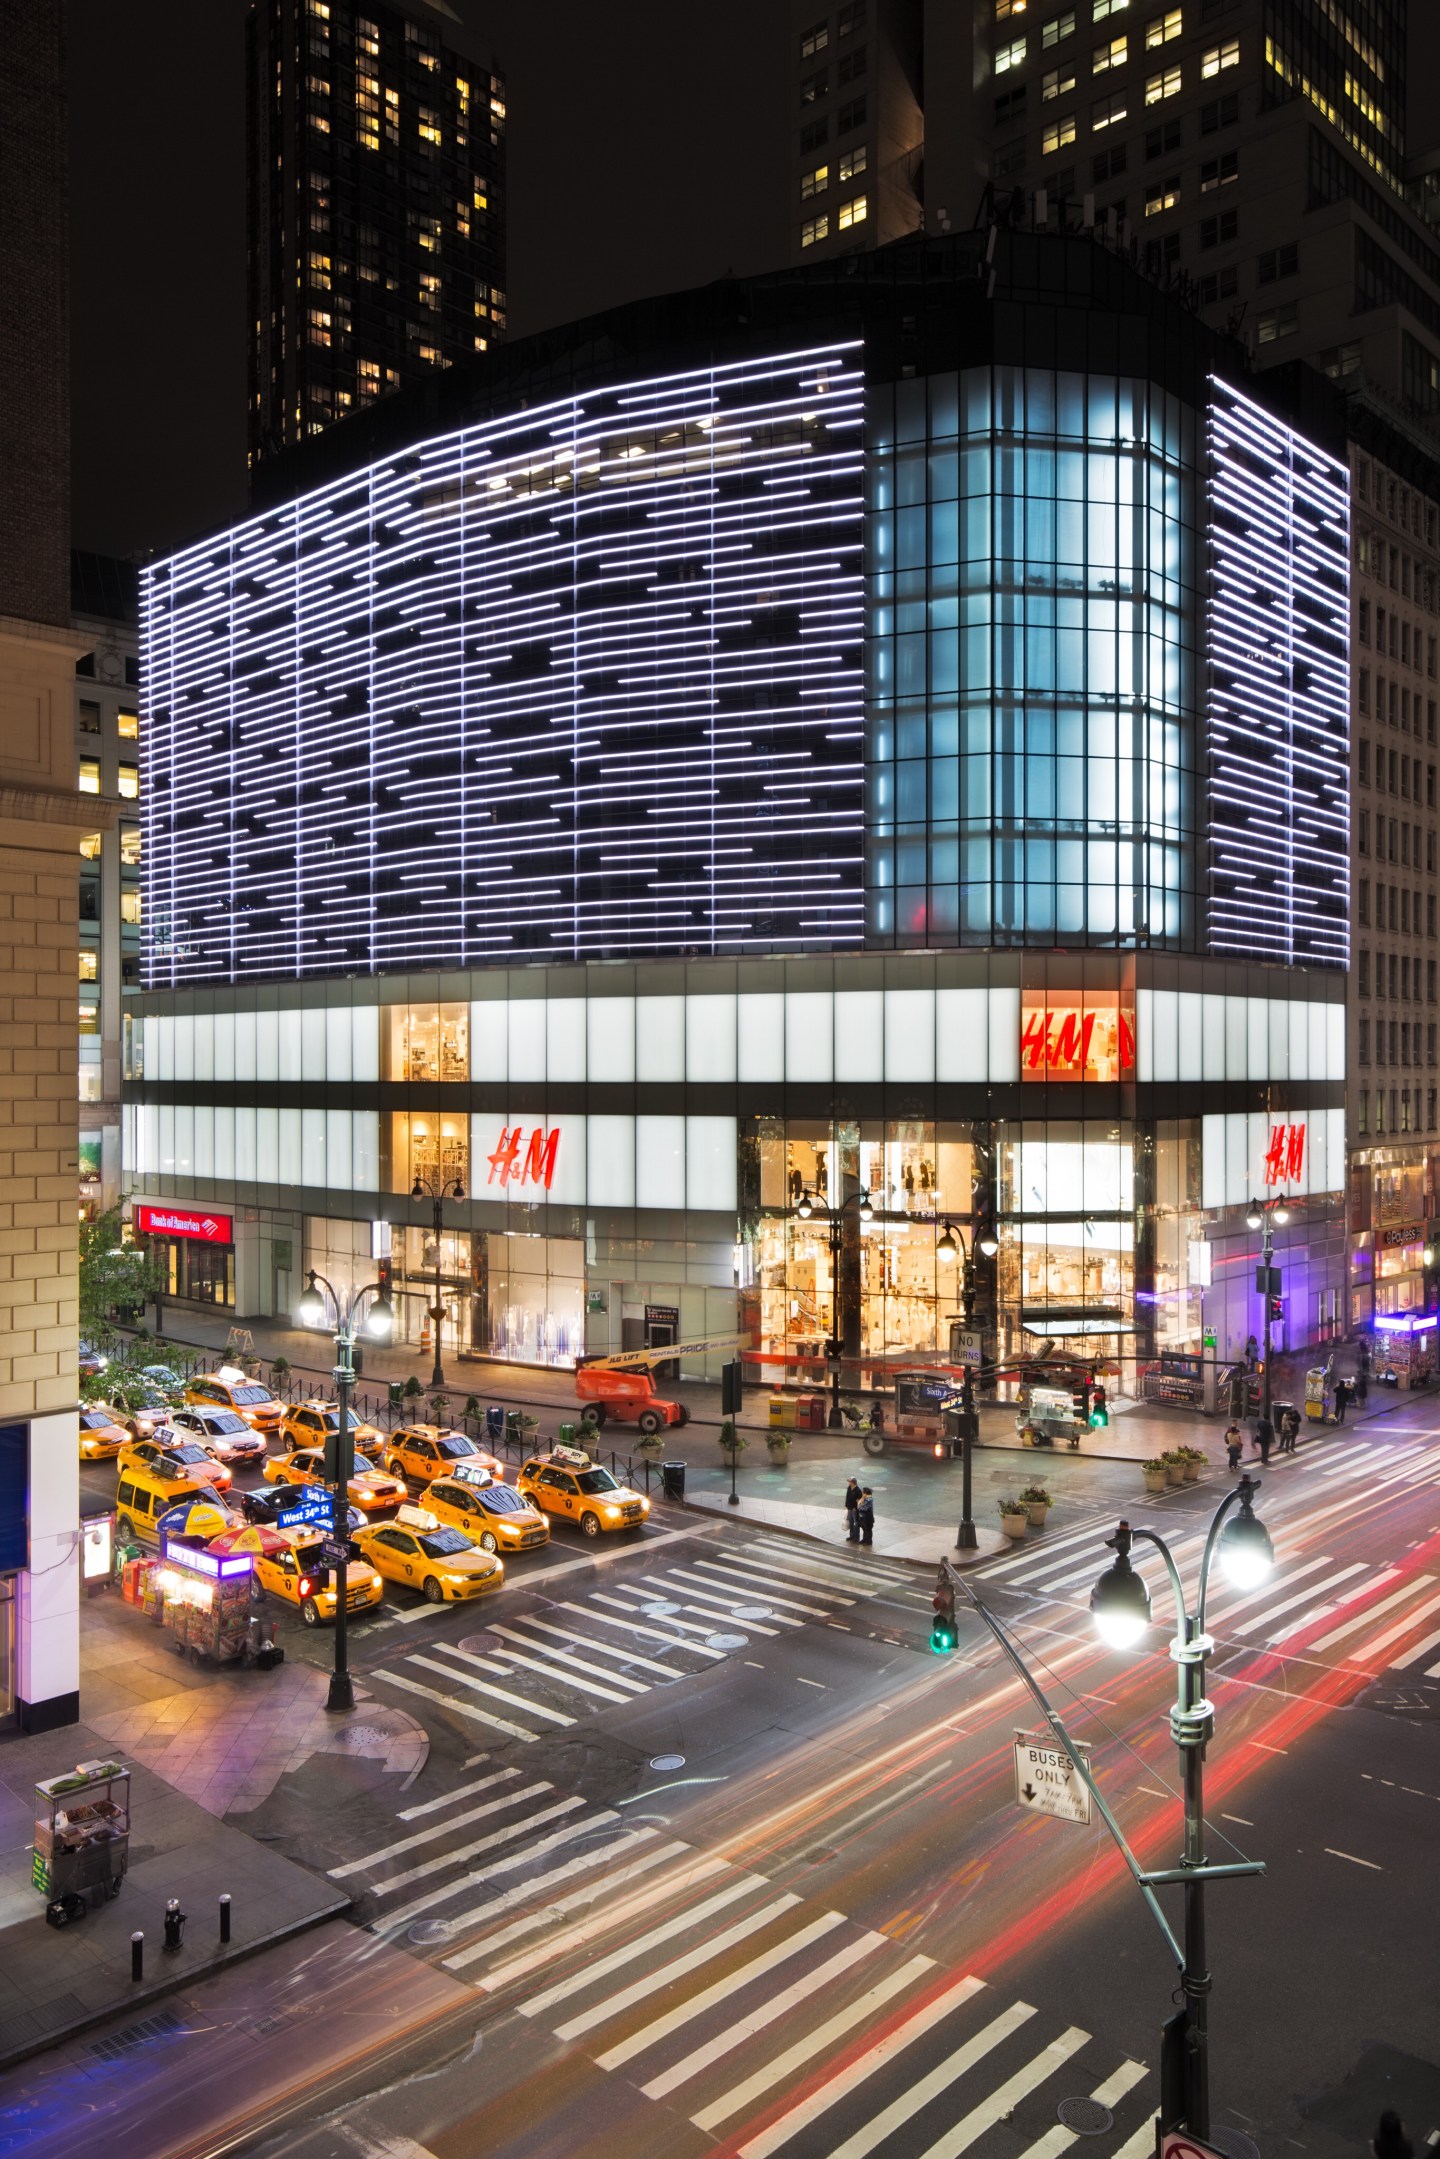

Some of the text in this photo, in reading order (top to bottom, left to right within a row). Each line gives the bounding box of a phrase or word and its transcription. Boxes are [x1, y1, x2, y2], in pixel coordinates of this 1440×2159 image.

[1021, 1012, 1096, 1068] H&M
[487, 1126, 560, 1190] H&M
[1265, 1124, 1305, 1186] H&M
[150, 1213, 200, 1233] Bank of America
[680, 1342, 709, 1354] PRIDE
[958, 1335, 974, 1347] NO
[607, 1353, 641, 1365] JLG LIFT
[953, 1349, 980, 1361] TURNS
[926, 1387, 942, 1397] Sixth
[282, 1512, 304, 1524] West
[304, 1506, 320, 1519] 34th
[320, 1505, 330, 1515] St
[1029, 1750, 1075, 1771] BUSES
[1035, 1768, 1071, 1787] ONLY
[1074, 1809, 1087, 1819] FRI
